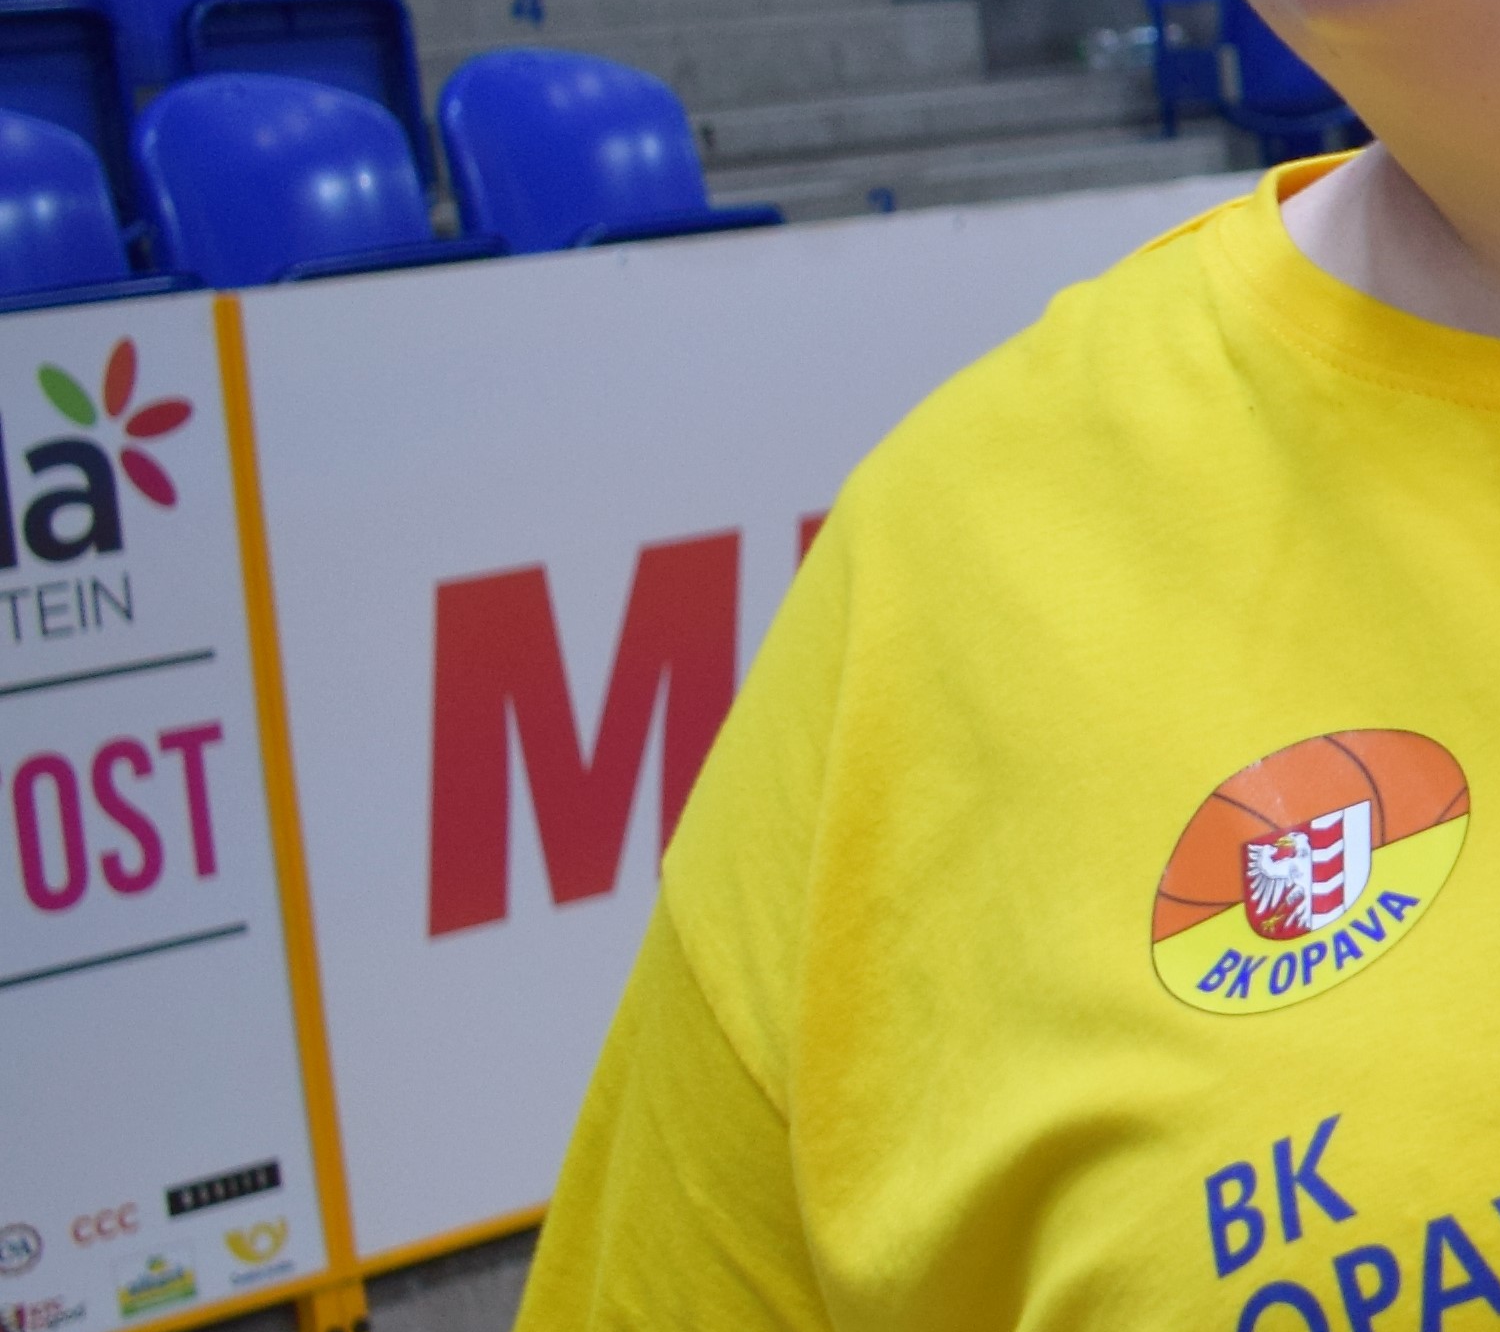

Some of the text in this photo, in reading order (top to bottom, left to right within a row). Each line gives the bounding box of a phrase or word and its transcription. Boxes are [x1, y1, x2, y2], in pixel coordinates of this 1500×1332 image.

[427, 506, 832, 940] M
[1197, 888, 1421, 999] BK OPAVA
[1203, 1113, 1357, 1279] BK
